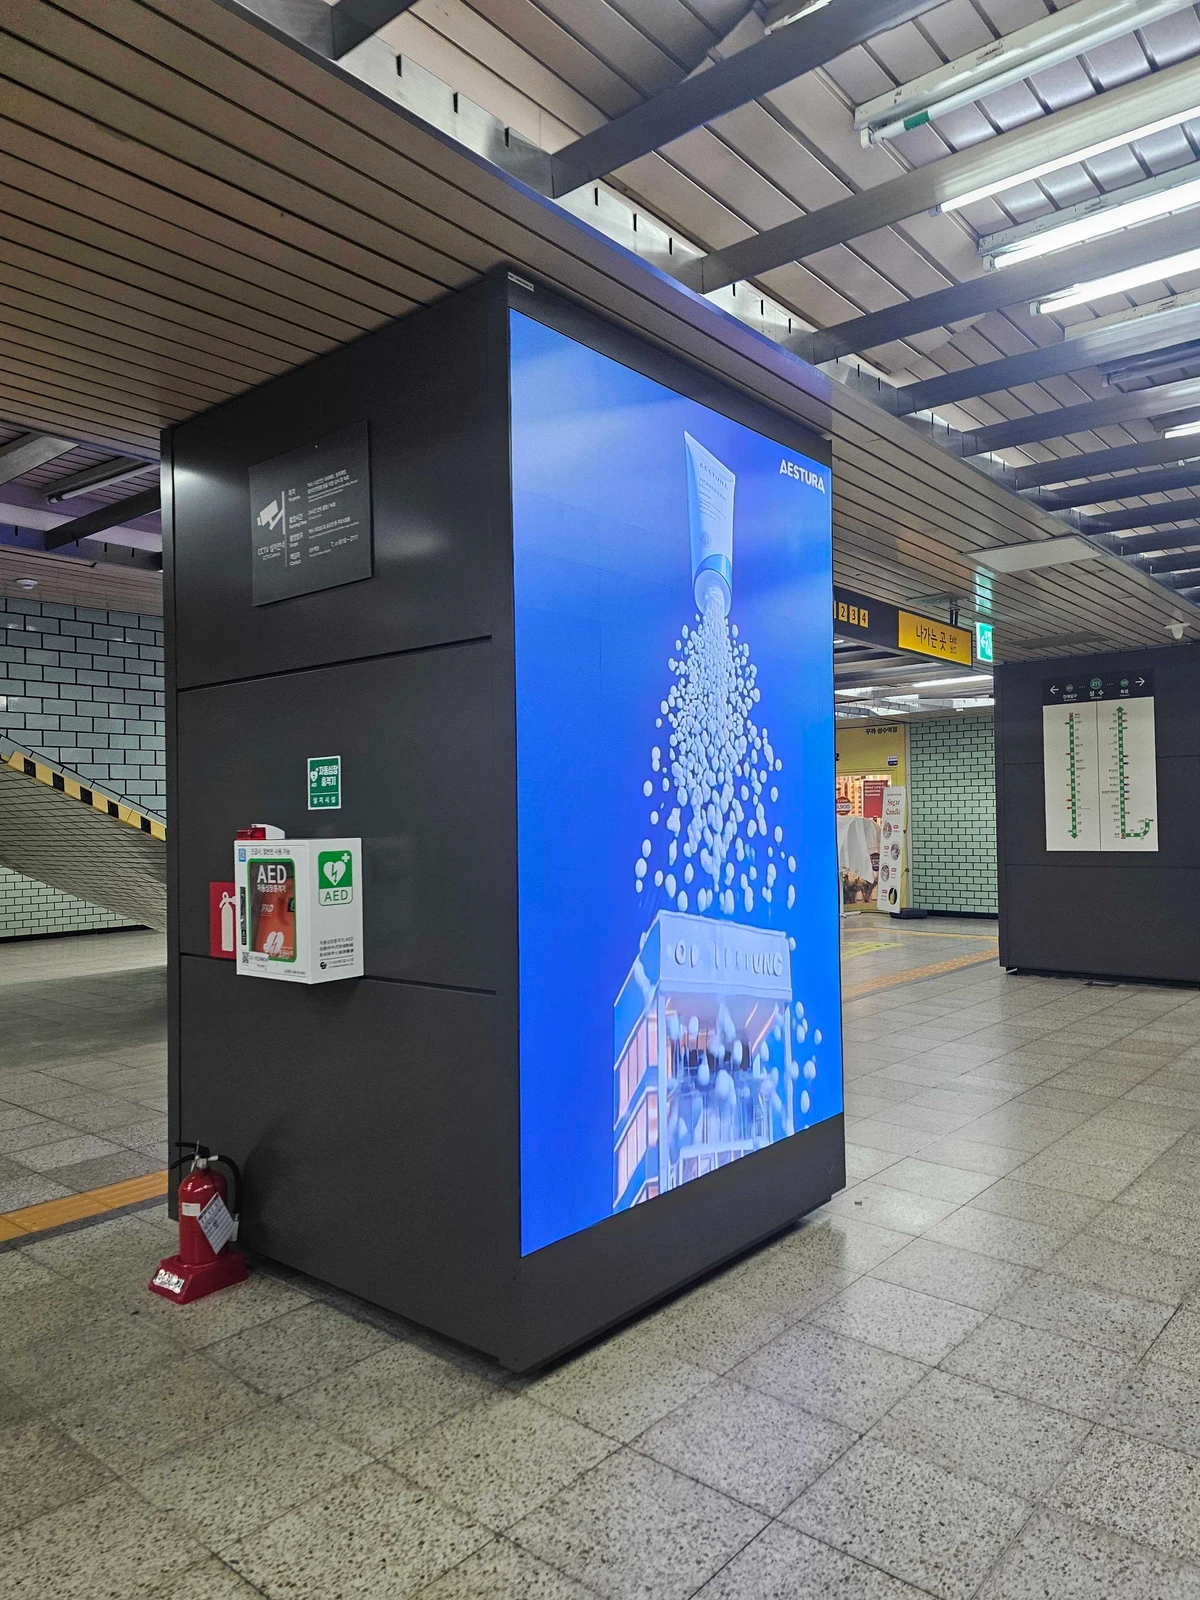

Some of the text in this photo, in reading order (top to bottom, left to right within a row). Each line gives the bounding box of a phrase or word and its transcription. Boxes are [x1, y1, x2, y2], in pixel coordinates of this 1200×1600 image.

[779, 459, 825, 494] AESTURA
[916, 624, 947, 651] 나가는 곳
[949, 634, 958, 645] Exit
[256, 864, 287, 884] AED
[324, 889, 349, 903] AED
